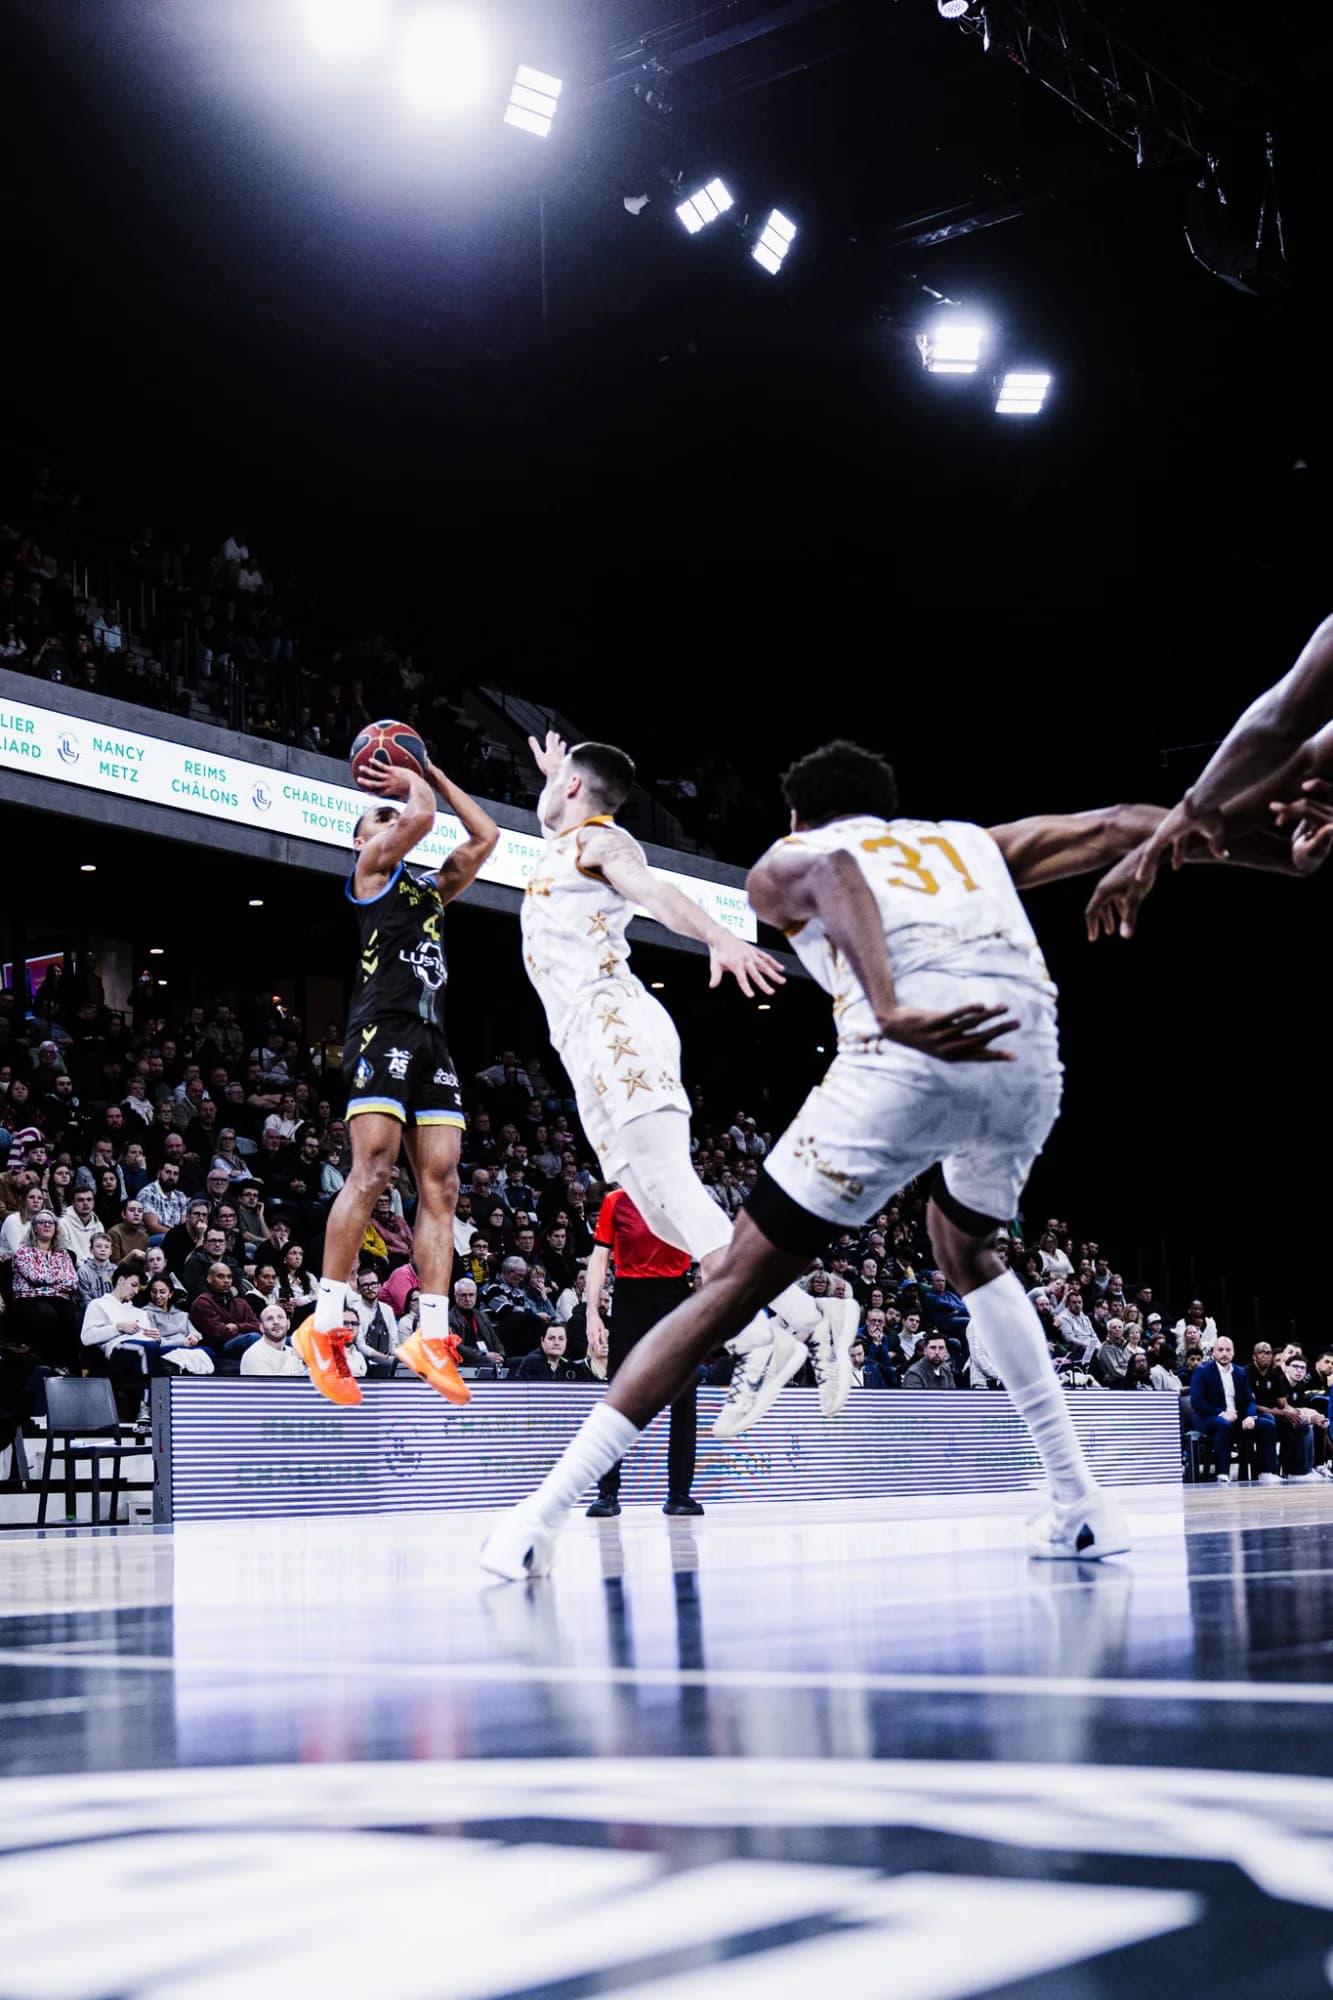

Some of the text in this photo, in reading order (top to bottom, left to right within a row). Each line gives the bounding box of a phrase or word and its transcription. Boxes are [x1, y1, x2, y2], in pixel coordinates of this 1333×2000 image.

[0, 735, 42, 759] IARD
[92, 738, 146, 763] NANCY
[99, 761, 139, 784] METZ
[184, 759, 227, 783] REIMS
[171, 778, 240, 808] CHÂLONS
[301, 810, 352, 834] TROYES
[433, 824, 457, 841] JON
[860, 836, 979, 896] 31
[720, 913, 745, 929] METZ
